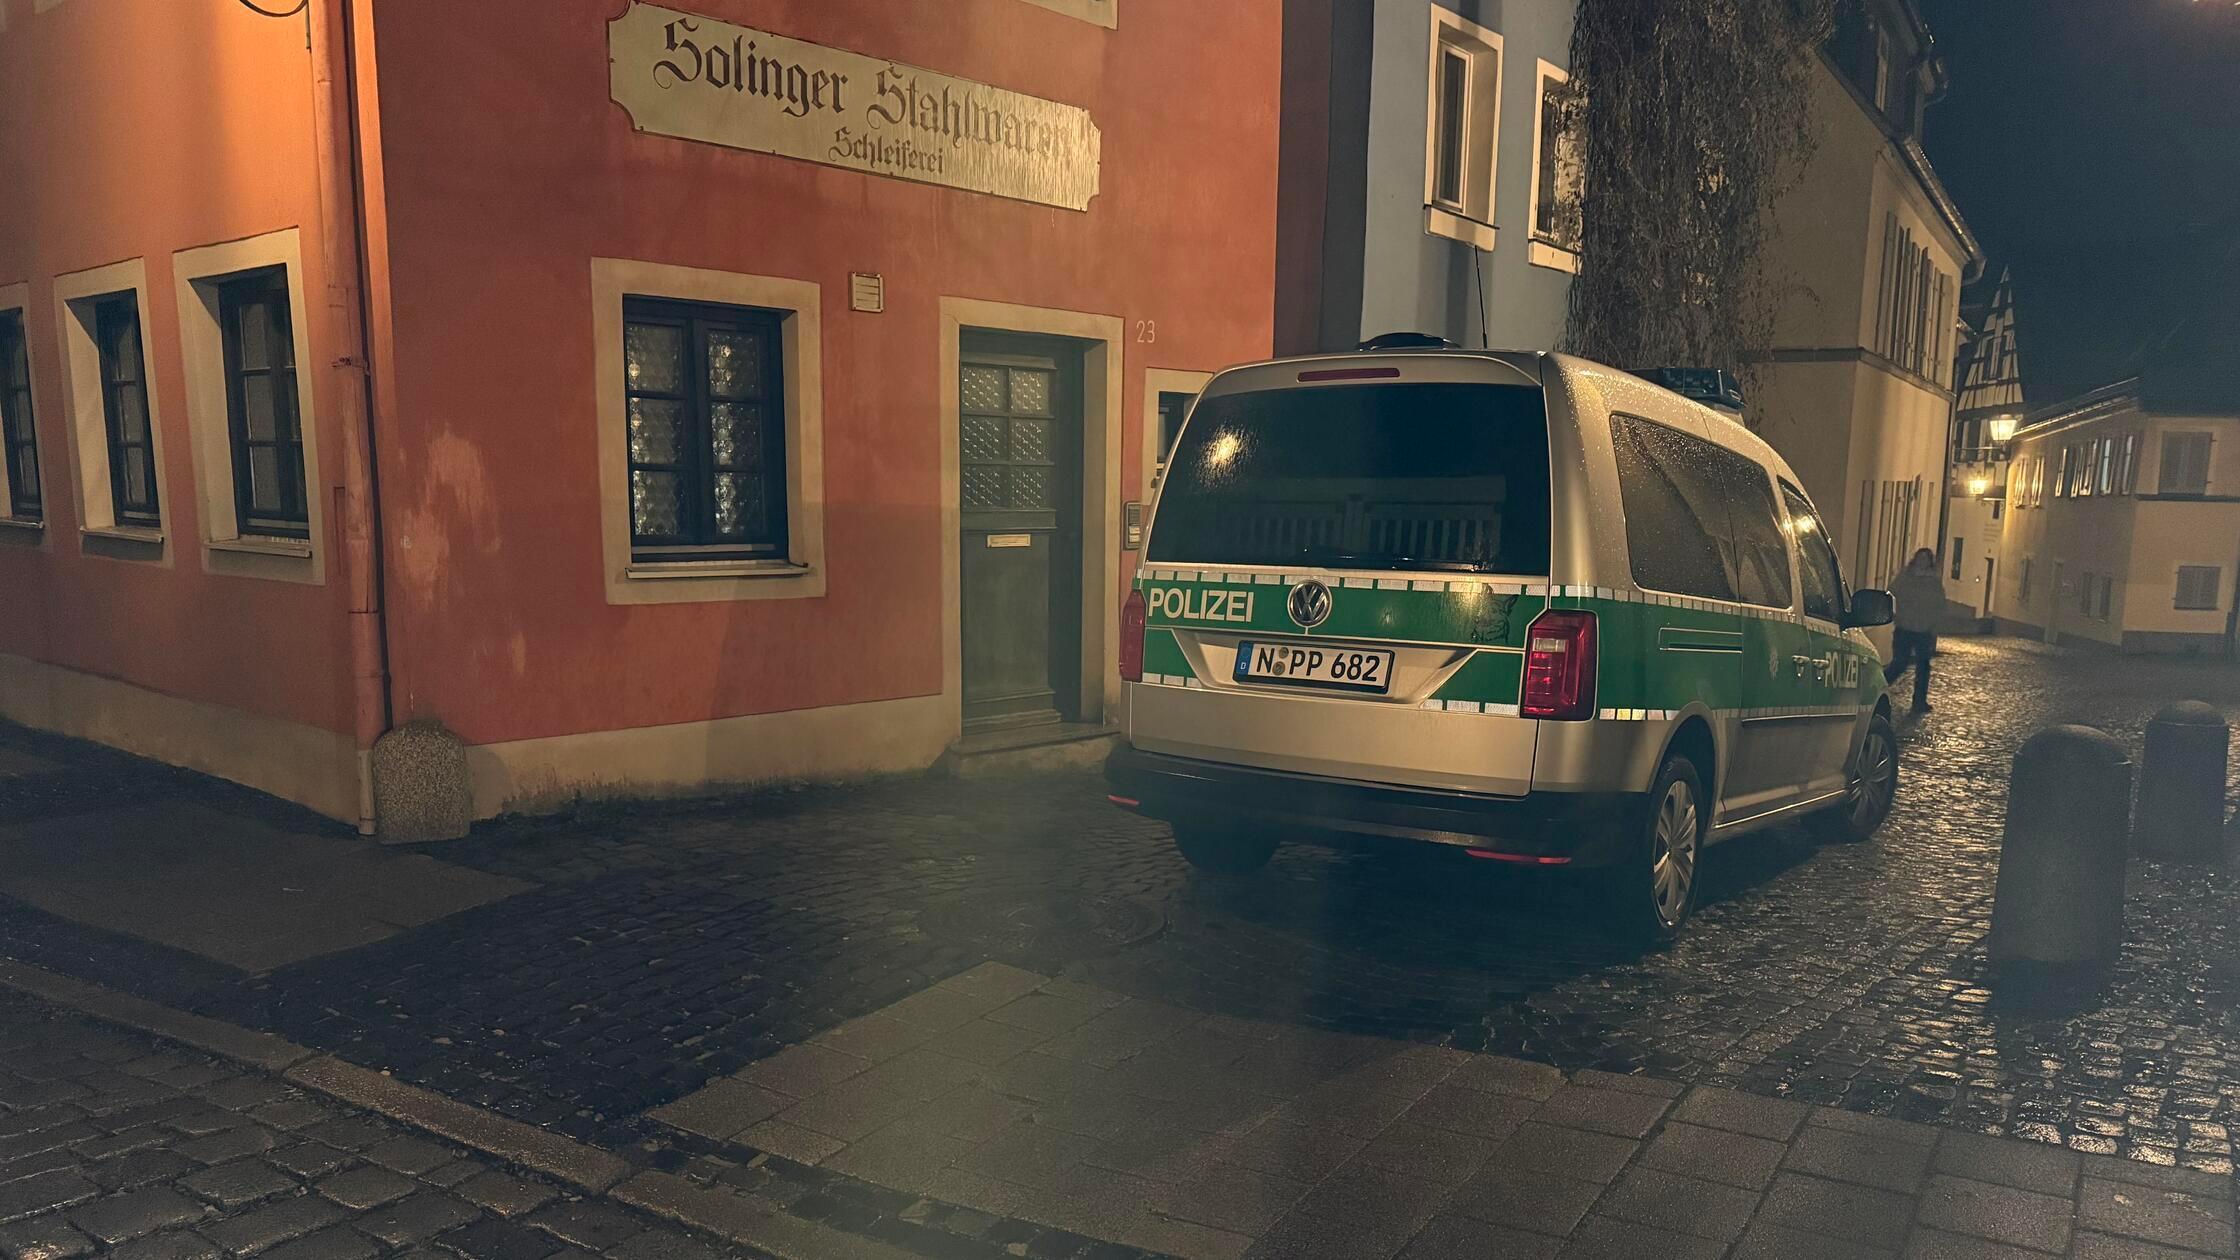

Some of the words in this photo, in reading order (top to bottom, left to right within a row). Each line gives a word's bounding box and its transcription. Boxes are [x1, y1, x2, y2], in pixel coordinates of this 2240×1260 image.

[652, 17, 849, 118] Solinger
[866, 65, 1073, 160] Stahlwaren
[828, 126, 944, 174] Schleiferei
[1136, 320, 1155, 343] 23
[1148, 587, 1255, 623] POLIZEI
[1290, 581, 1330, 625] VW
[1256, 647, 1275, 673] N
[1289, 650, 1323, 676] PP
[1330, 653, 1380, 682] 682
